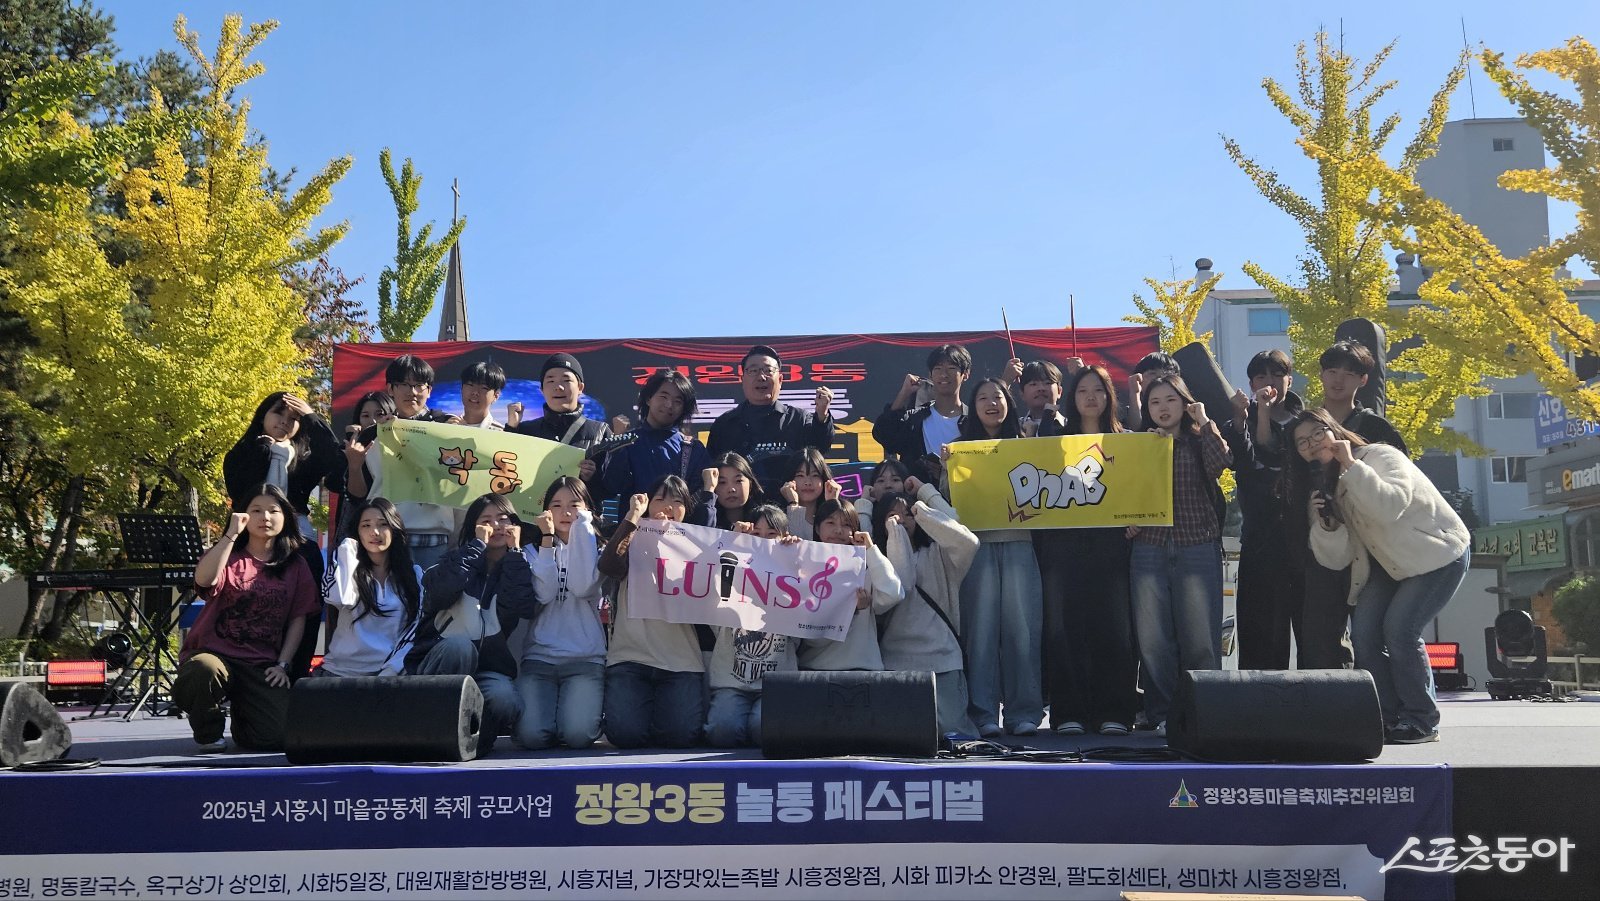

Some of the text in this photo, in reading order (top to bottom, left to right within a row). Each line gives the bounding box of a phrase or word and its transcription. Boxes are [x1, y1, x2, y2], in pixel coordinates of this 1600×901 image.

[203, 794, 552, 823] 2025년 시흥시 마을공동체 축제 공모사업
[574, 780, 984, 825] 정왕3동 놀통 페스티벌
[1203, 786, 1415, 806] 정왕3동마을축제추진위원회
[41, 876, 140, 898] 명동칼국수,
[146, 874, 224, 896] 옥구상가
[228, 873, 291, 896] 상인회,
[297, 872, 390, 894] 시화5일장,
[396, 869, 550, 892] 대원재활한방병원,
[557, 868, 638, 891] 시흥저널,
[644, 867, 780, 889] 가장맛있는족발
[784, 866, 886, 888] 시흥정왕점,
[891, 866, 930, 886] 시화
[935, 866, 993, 886] 피카소
[998, 866, 1062, 888] 안경원,
[1067, 866, 1171, 889] 팔도회센타,
[1177, 868, 1238, 889] 생마차
[1243, 868, 1347, 890] 시흥정왕점,
